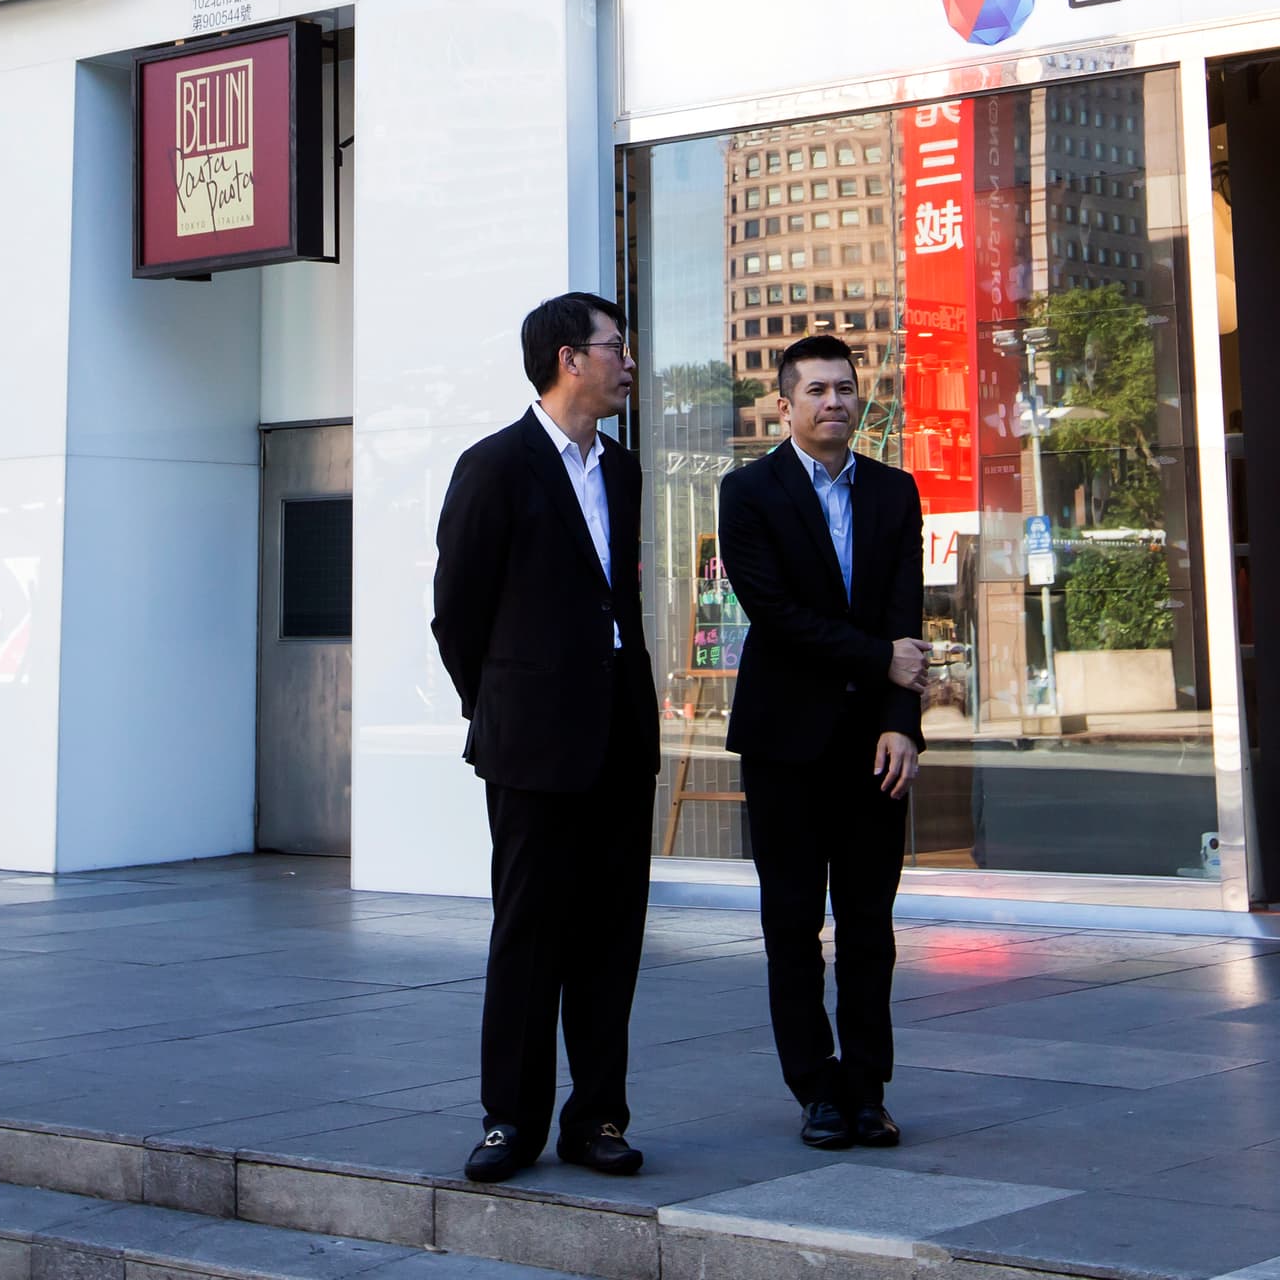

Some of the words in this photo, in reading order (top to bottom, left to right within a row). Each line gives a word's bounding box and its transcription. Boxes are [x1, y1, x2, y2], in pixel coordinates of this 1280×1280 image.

[183, 70, 246, 154] BELLINI
[170, 146, 231, 212] Pasta
[206, 160, 254, 232] Pasta
